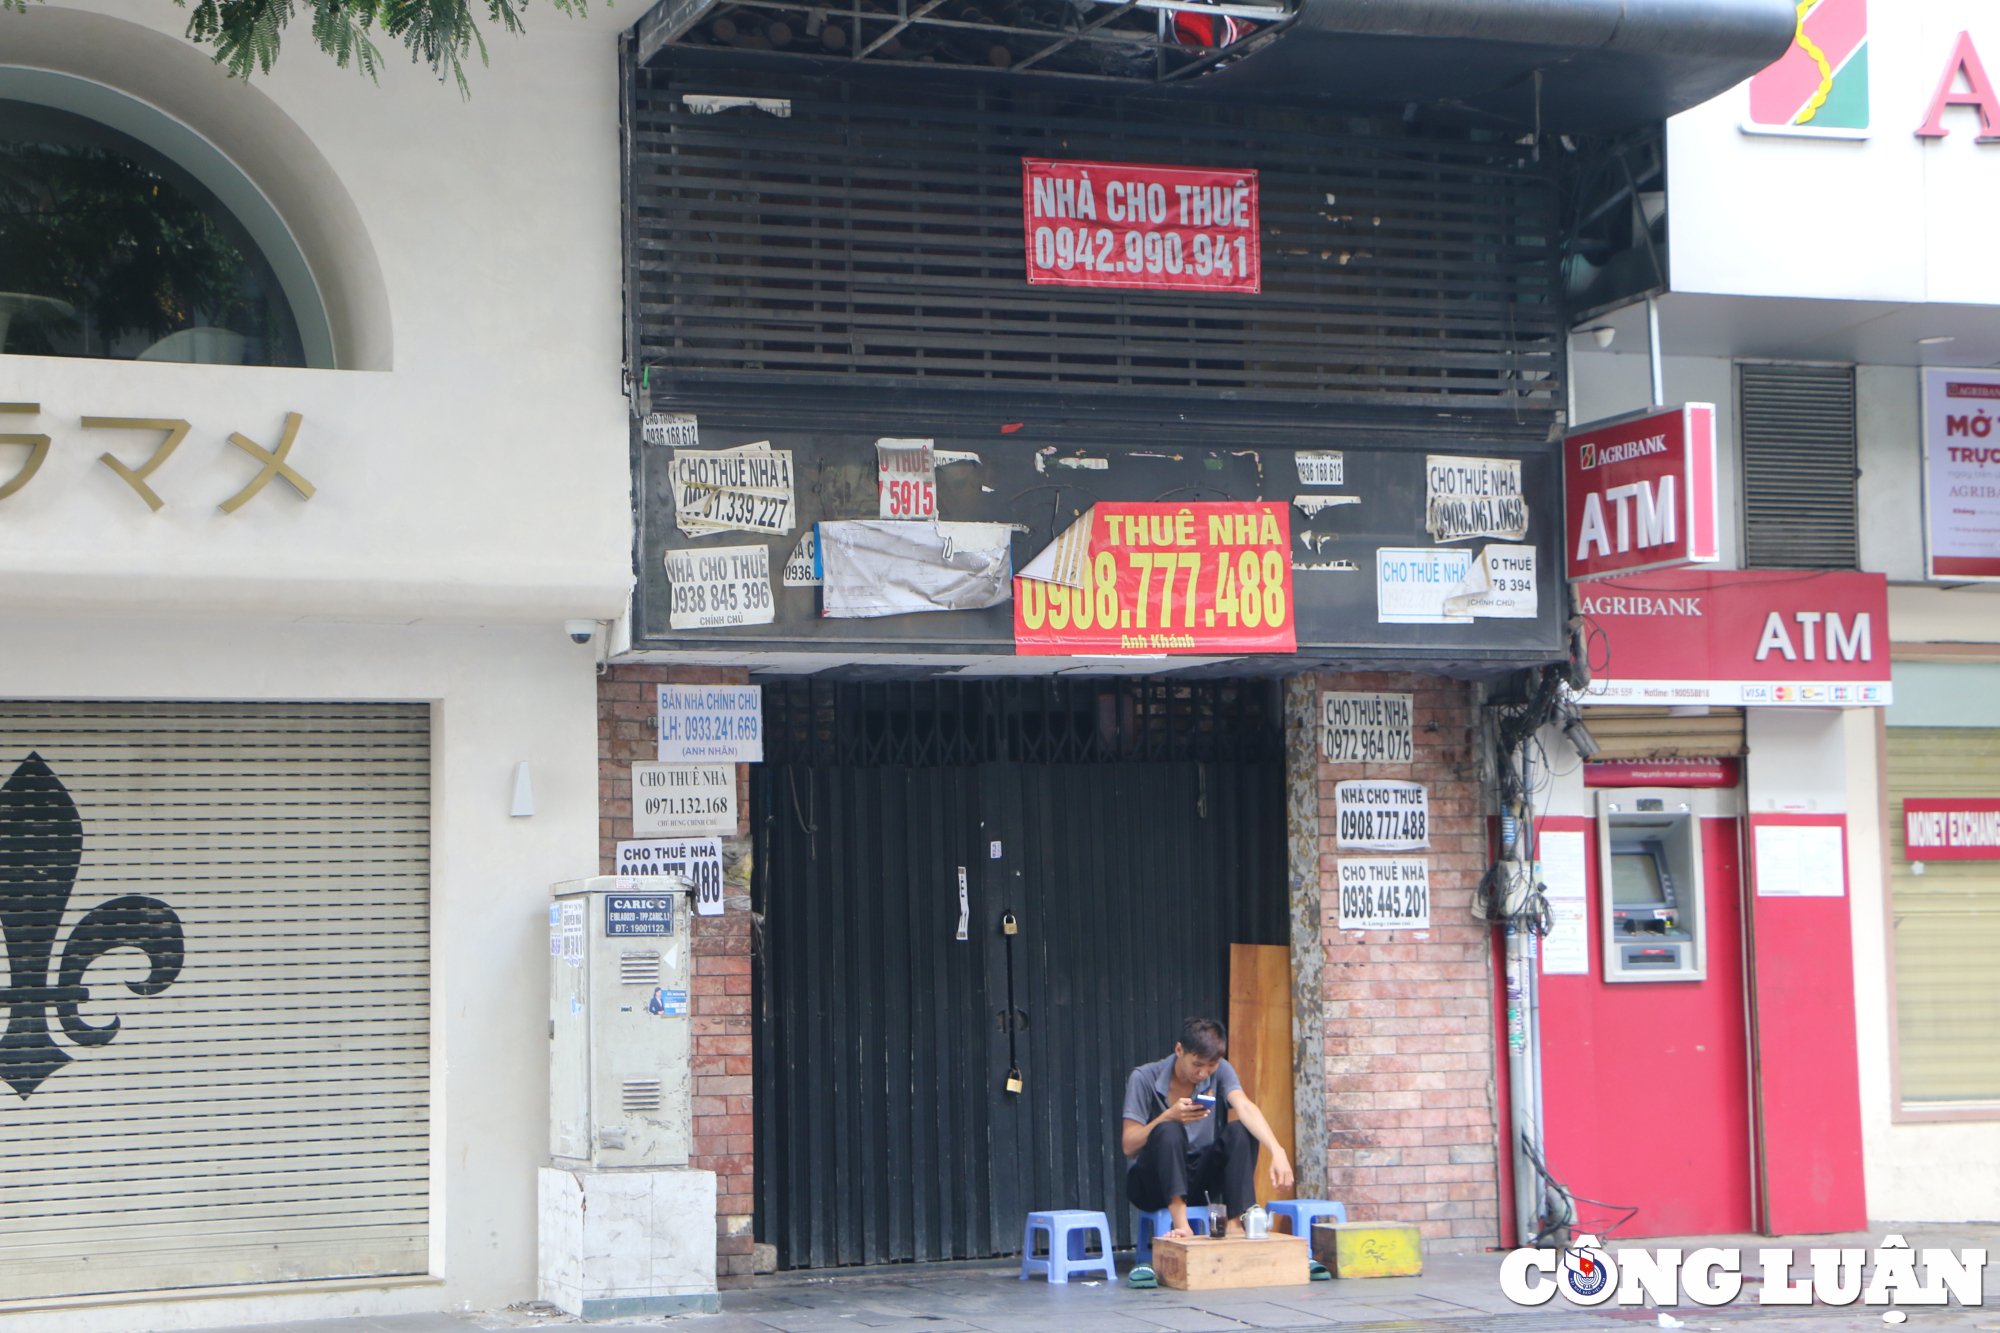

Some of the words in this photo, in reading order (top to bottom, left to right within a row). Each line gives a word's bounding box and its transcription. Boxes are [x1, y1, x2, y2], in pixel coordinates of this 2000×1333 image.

[1033, 171, 1096, 220] NHÀ
[1106, 181, 1167, 224] CHO
[1175, 179, 1249, 227] THUÊ
[1035, 226, 1247, 278] 0942.990.941
[667, 426, 681, 444] 168
[682, 425, 697, 444] 612
[1598, 434, 1667, 466] AGRIBANK
[680, 458, 708, 483] CHO
[709, 453, 746, 487] THUÊ
[750, 453, 779, 487] NHÀ
[1430, 467, 1455, 494] CHO
[1458, 464, 1488, 495] THUÊ
[1491, 463, 1516, 496] NHÀ
[889, 480, 934, 515] 5915
[1949, 485, 2000, 498] AGRIB
[1104, 508, 1196, 546] THUÊ
[1208, 508, 1283, 546] NHÀ
[1576, 475, 1676, 560] ATM
[666, 551, 695, 583] NHÀ
[700, 554, 728, 582] CHO
[731, 547, 768, 580] THUÊ
[784, 565, 821, 580] 0936.
[1383, 561, 1407, 582] CHO
[1410, 557, 1440, 583] THUÊ
[1504, 556, 1532, 571] THUÊ
[710, 583, 738, 612] 845
[742, 581, 770, 610] 396
[1022, 550, 1286, 630] 0908.777.488
[1510, 580, 1531, 592] 394
[700, 615, 725, 626] CHÍNH
[1580, 596, 1702, 617] AGRIBANK
[1755, 611, 1872, 661] ATM
[1121, 635, 1147, 649] Anh
[1152, 634, 1195, 649] Khánh
[684, 689, 704, 710] NHÀ
[706, 689, 736, 711] CHÍNH
[1326, 699, 1350, 725] CHO
[1352, 695, 1382, 726] THUÊ
[1385, 695, 1408, 726] NHÀ
[662, 716, 682, 741] LH:
[685, 716, 757, 741] 0933.241.669
[1327, 729, 1358, 760] 0972
[1361, 729, 1384, 760] 964
[1388, 730, 1411, 760] 076
[640, 771, 666, 787] CHO
[668, 766, 700, 787] THUÊ
[703, 767, 727, 786] NHÀ
[645, 797, 728, 815] 0971.132.168
[1341, 784, 1365, 804] NHÀ
[1368, 789, 1389, 804] CHO
[1393, 786, 1423, 804] THUÊ
[1341, 810, 1425, 840] 0908.777.488
[624, 848, 651, 861] CHO
[655, 843, 686, 859] THUÊ
[690, 842, 717, 857] NHÀ
[1342, 866, 1366, 881] CHO
[1369, 861, 1398, 881] THUÊ
[1402, 861, 1425, 881] NHÀ
[614, 900, 654, 909] CARIC
[1343, 885, 1427, 918] 0936.445.201
